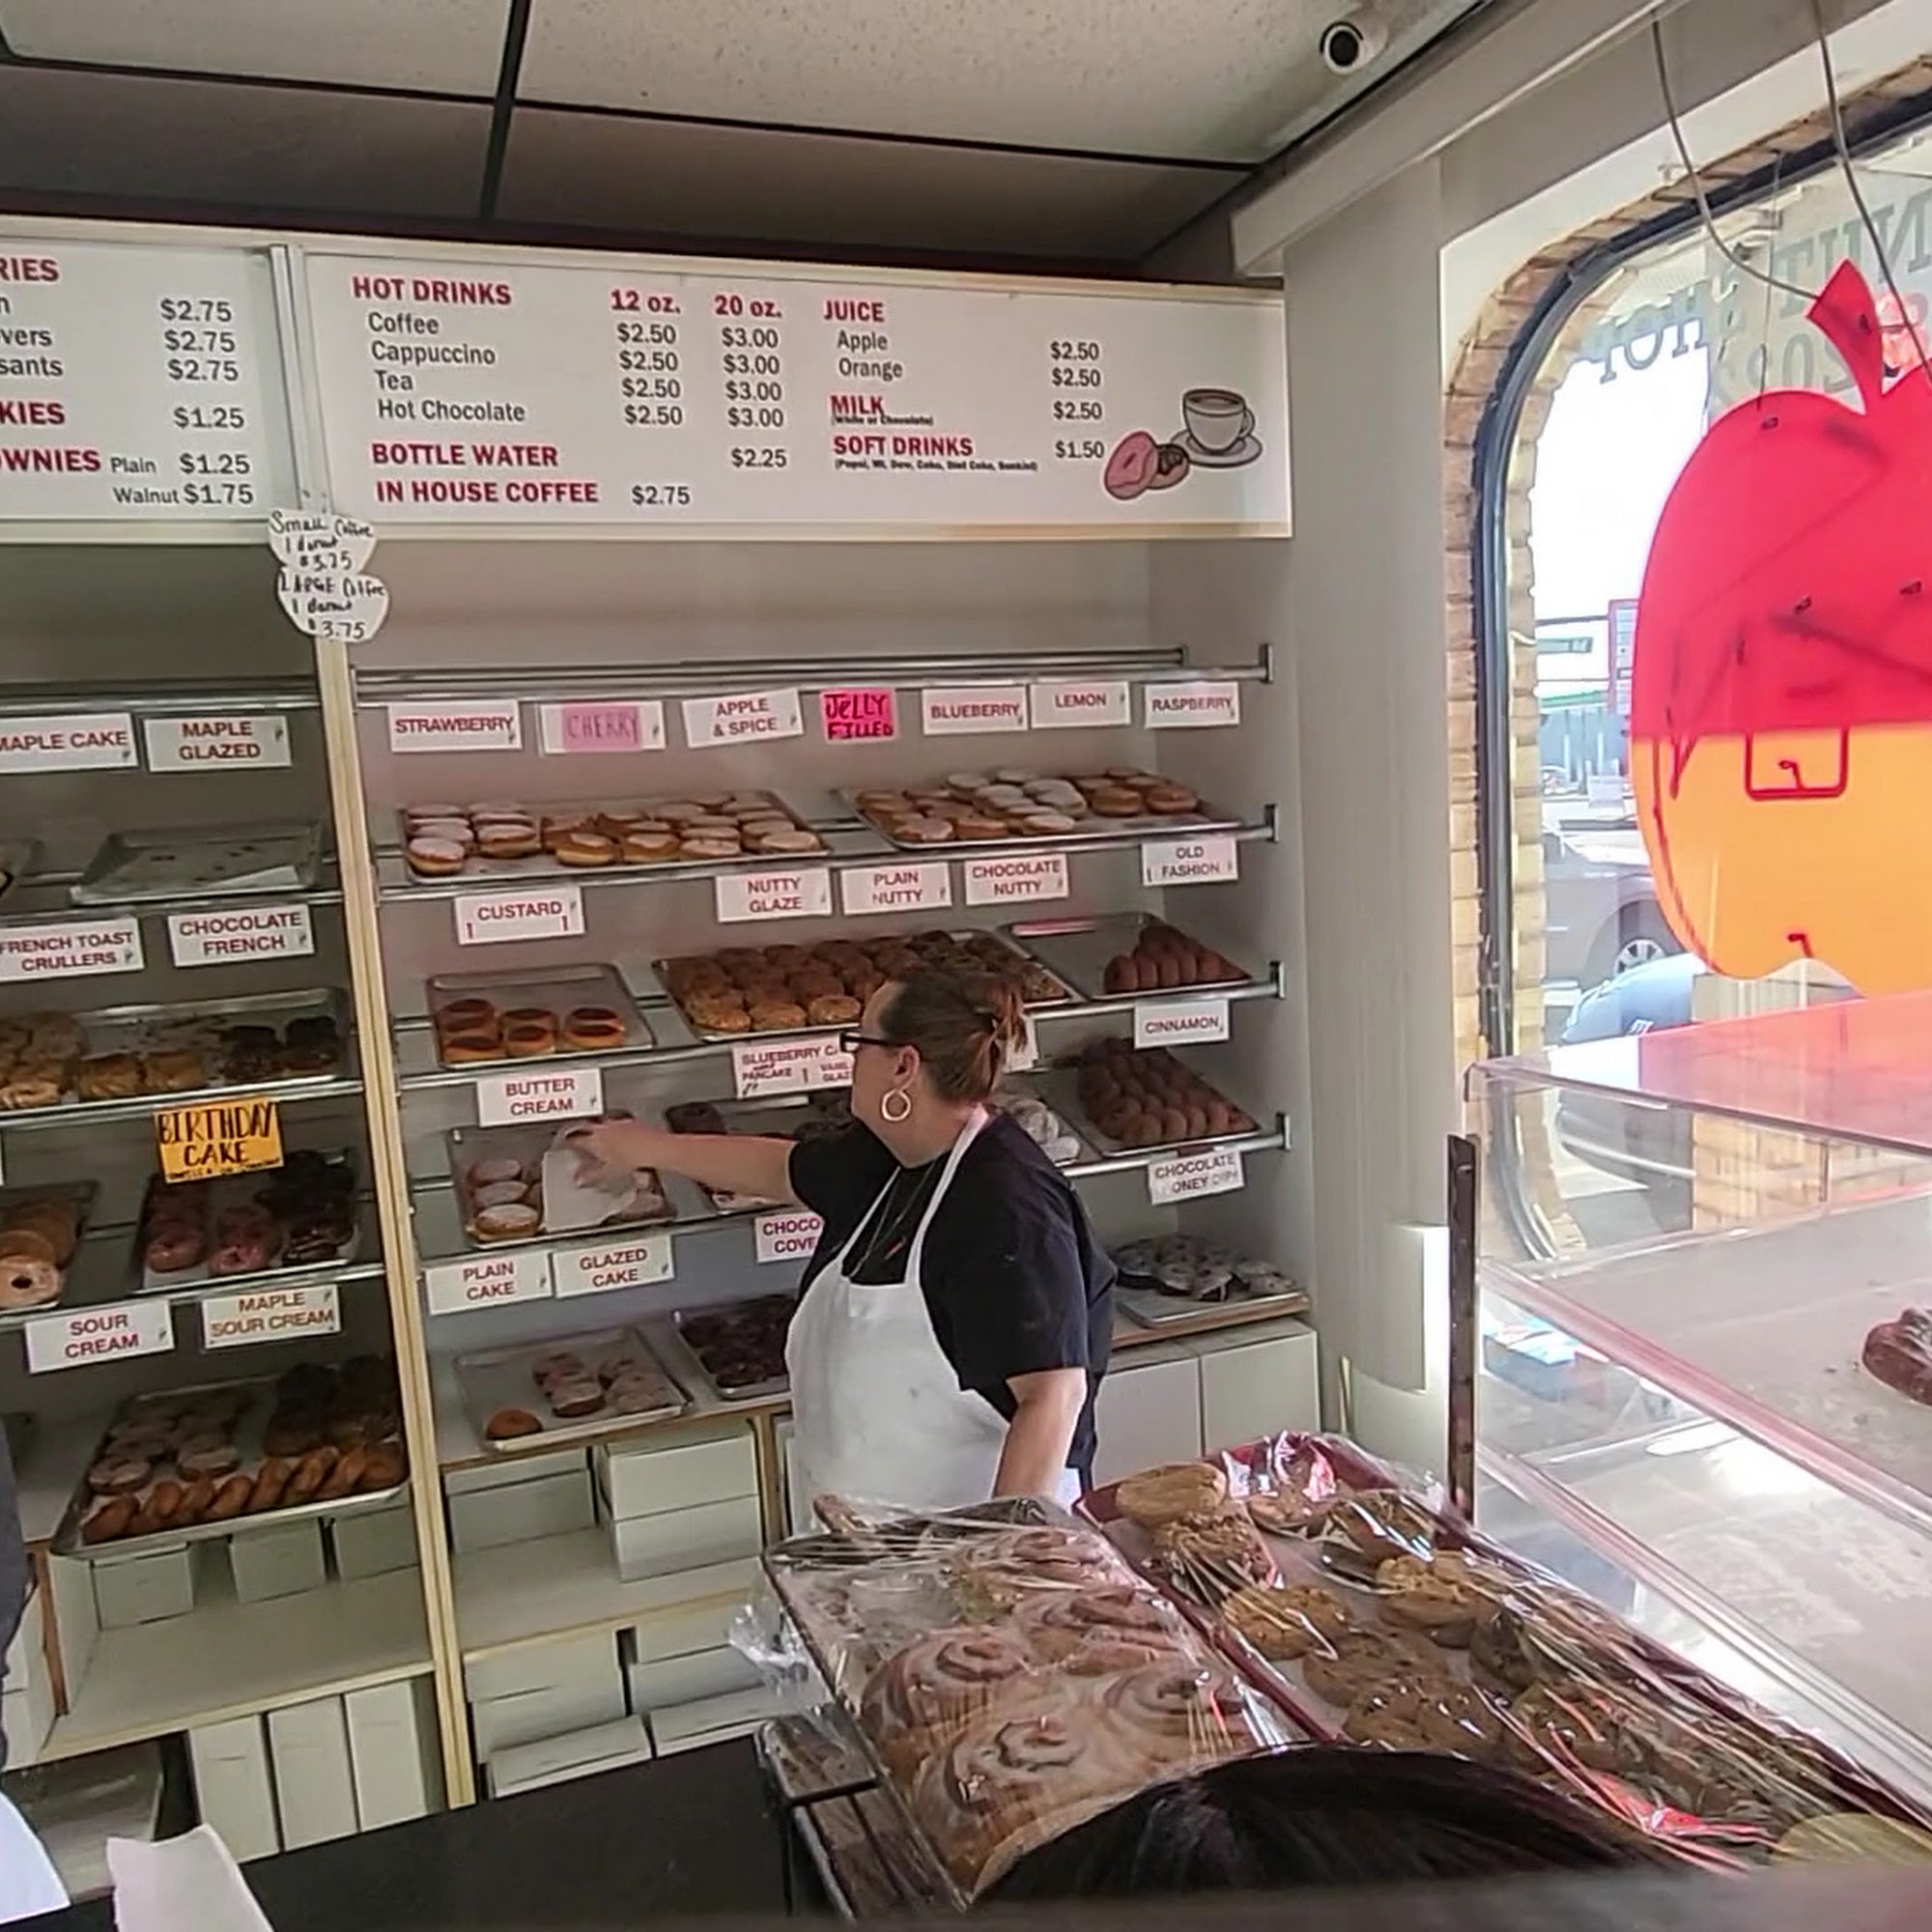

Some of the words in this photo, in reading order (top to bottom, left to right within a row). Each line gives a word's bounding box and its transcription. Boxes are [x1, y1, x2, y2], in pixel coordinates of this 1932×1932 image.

[353, 276, 409, 299] HOT
[414, 280, 512, 305] DRINKS
[160, 298, 232, 322] $2.75
[611, 291, 640, 311] 12
[647, 295, 681, 314] oz.
[715, 296, 745, 316] 20
[751, 298, 782, 318] oz.
[824, 300, 885, 322] JUICE
[368, 312, 440, 335] Coffee
[164, 329, 236, 353] $2.75
[617, 324, 676, 346] $2.50
[722, 327, 779, 349] $3.00
[837, 330, 888, 354] Apple
[372, 341, 496, 366] Cappuccino
[620, 351, 678, 372] $2.50
[1050, 342, 1099, 361] $2.50
[168, 359, 239, 382] $2.75
[724, 355, 780, 376] $3.00
[838, 357, 903, 382] Orange
[375, 369, 413, 391] Tea
[1052, 368, 1101, 387] $2.50
[622, 378, 681, 400] $2.50
[725, 381, 781, 403] $3.00
[0, 401, 66, 425] KIES
[379, 399, 416, 420] Hot
[421, 401, 526, 423] Chocolate
[831, 395, 884, 415] MILK
[1053, 402, 1103, 421] $2.50
[174, 407, 245, 429] $1.25
[624, 405, 683, 427] $2.50
[727, 407, 784, 428] $3.00
[372, 443, 465, 466] BOTTLE
[472, 444, 558, 468] WATER
[833, 436, 886, 456] SOFT
[894, 437, 974, 457] DRINKS
[1055, 440, 1105, 460] $1.50
[0, 448, 101, 472] WNIES
[110, 457, 156, 473] Plain
[180, 453, 250, 475] $1.25
[731, 448, 787, 469] $2.25
[114, 487, 180, 504] Walnut
[183, 483, 253, 505] $1.75
[377, 481, 403, 502] IN
[412, 482, 498, 503] HOUSE
[505, 482, 600, 504] COFFEE
[632, 485, 691, 507] $2.75
[716, 697, 769, 717] APPLE
[930, 702, 1020, 720] BLUEBERRY
[1055, 694, 1106, 708] LEMON
[1151, 696, 1232, 713] RASPBERRY
[182, 721, 253, 739] MAPLE
[395, 715, 514, 734] STRAWBERRY
[714, 724, 724, 737] &
[729, 718, 778, 735] SPICE
[827, 720, 894, 739] FILLED
[0, 734, 65, 751] MAPLE
[71, 730, 128, 749] CAKE
[179, 743, 262, 761] GLAZED
[1176, 845, 1205, 860] OLD
[873, 871, 919, 885] PLAIN
[972, 860, 1062, 879] CHOCOLATE
[1161, 861, 1220, 878] FASHION
[747, 877, 802, 895] NUTTY
[872, 888, 922, 905] NUTTY
[994, 880, 1042, 895] NUTTY
[477, 901, 563, 921] CUSTARD
[749, 896, 803, 914] GLAZE
[179, 912, 301, 937] CHOCOLATE
[0, 937, 72, 954] FRENCH
[76, 931, 133, 948] TOAST
[203, 936, 286, 956] FRENCH
[21, 952, 117, 972] CRULLERS
[1145, 1017, 1220, 1035] CINNAMON
[741, 1047, 821, 1065] BLUEBERRY
[742, 1067, 793, 1081] PANCAKE
[505, 1077, 576, 1097] BUTTER
[510, 1097, 574, 1116] CREAM
[157, 1101, 276, 1145] BIRTHDAY
[184, 1141, 247, 1168] CAKE
[1155, 1153, 1236, 1179] CHOCOLATE
[1172, 1176, 1209, 1194] ONEY
[762, 1217, 821, 1236] CHOCO
[580, 1248, 647, 1271] GLAZED
[463, 1260, 515, 1282] PLAIN
[592, 1268, 639, 1288] CAKE
[466, 1281, 515, 1300] CAKE
[240, 1292, 305, 1314] MAPLE
[70, 1314, 128, 1337] SOUR
[210, 1317, 265, 1339] SOUR
[269, 1309, 335, 1330] CREAM
[65, 1333, 139, 1359] CREAM
